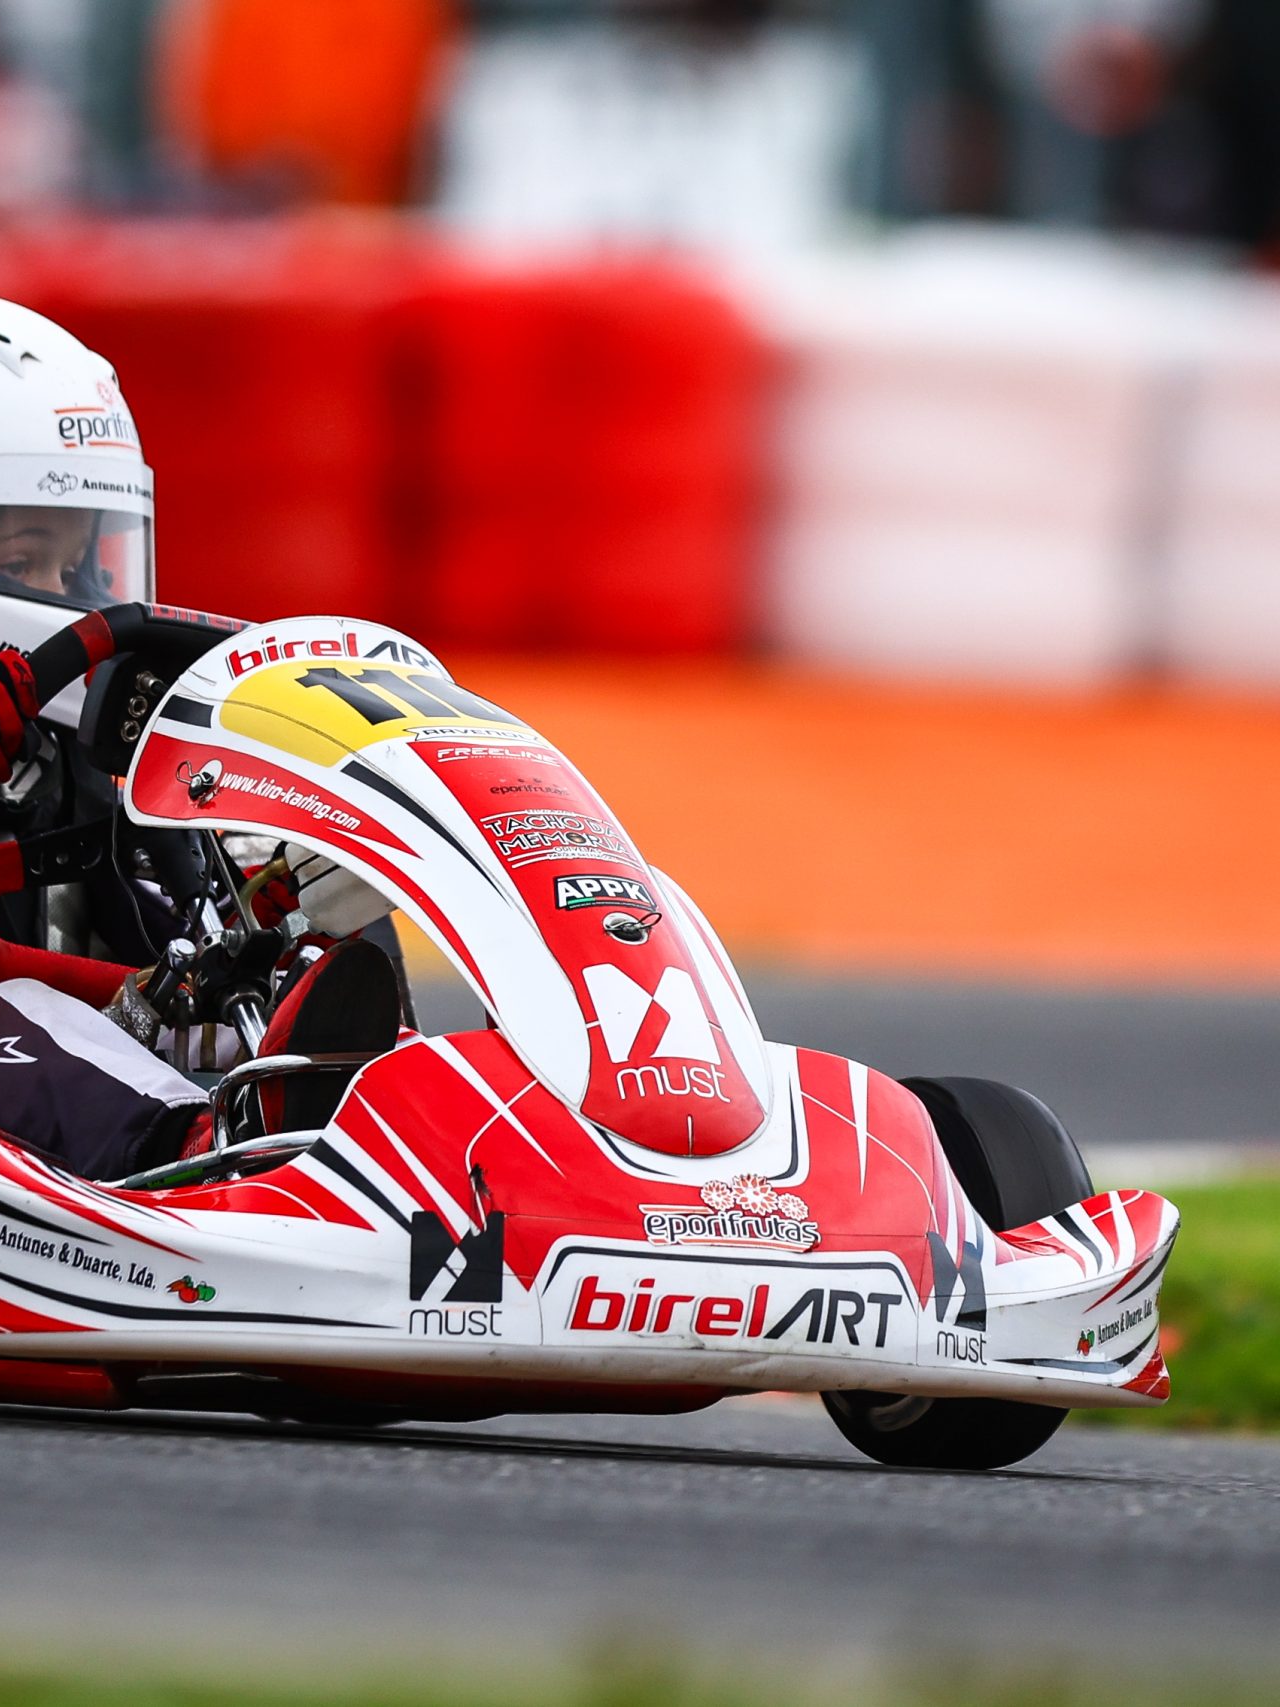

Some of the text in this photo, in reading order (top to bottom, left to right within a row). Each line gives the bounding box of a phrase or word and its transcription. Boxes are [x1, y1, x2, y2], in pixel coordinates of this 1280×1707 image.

[437, 747, 559, 763] FREELINE
[219, 772, 361, 831] www.kiro-karting.com
[483, 814, 585, 837] TACHO
[557, 879, 648, 909] APPK
[616, 1064, 731, 1103] must
[646, 1211, 819, 1243] eporifrutas
[58, 1242, 70, 1264] &
[71, 1247, 122, 1283] Duarte,
[127, 1262, 157, 1290] Lda.
[408, 1304, 503, 1337] must
[566, 1276, 903, 1348] birelART
[936, 1330, 988, 1366] must
